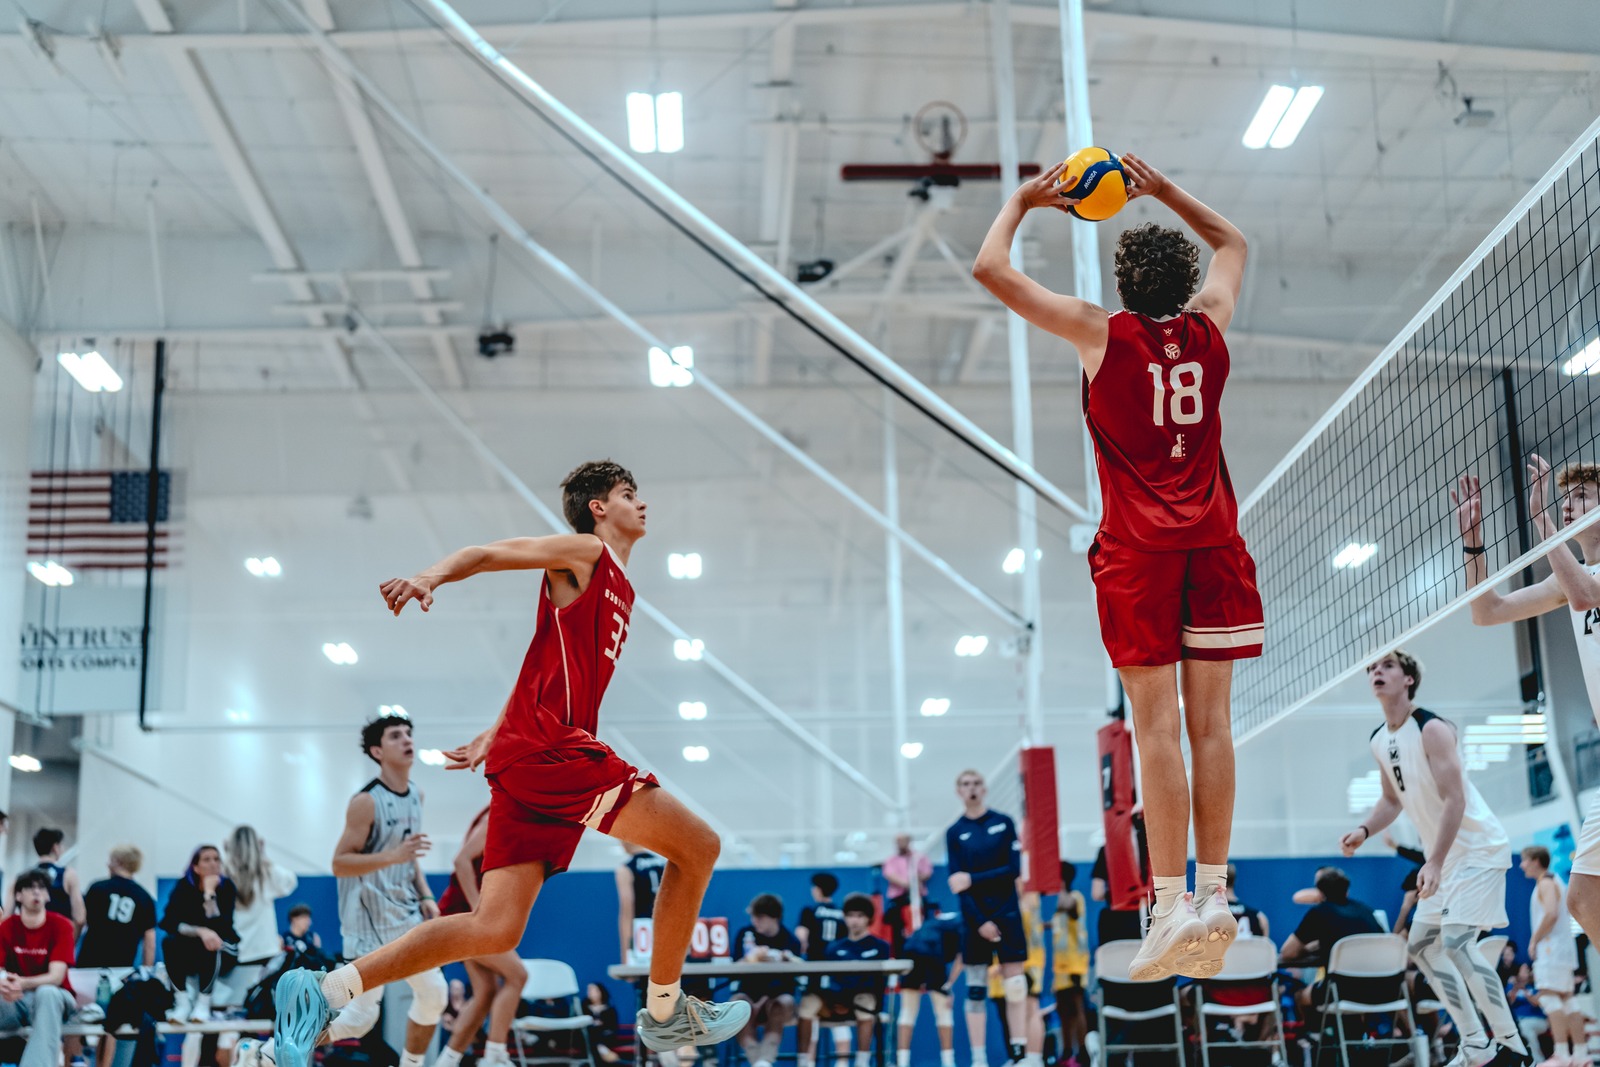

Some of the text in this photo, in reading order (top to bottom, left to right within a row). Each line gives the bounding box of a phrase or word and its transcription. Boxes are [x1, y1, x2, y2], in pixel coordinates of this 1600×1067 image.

[1147, 361, 1204, 427] 18
[1393, 765, 1405, 791] 8
[108, 893, 136, 924] 19
[691, 921, 729, 956] 09
[822, 919, 837, 941] 11
